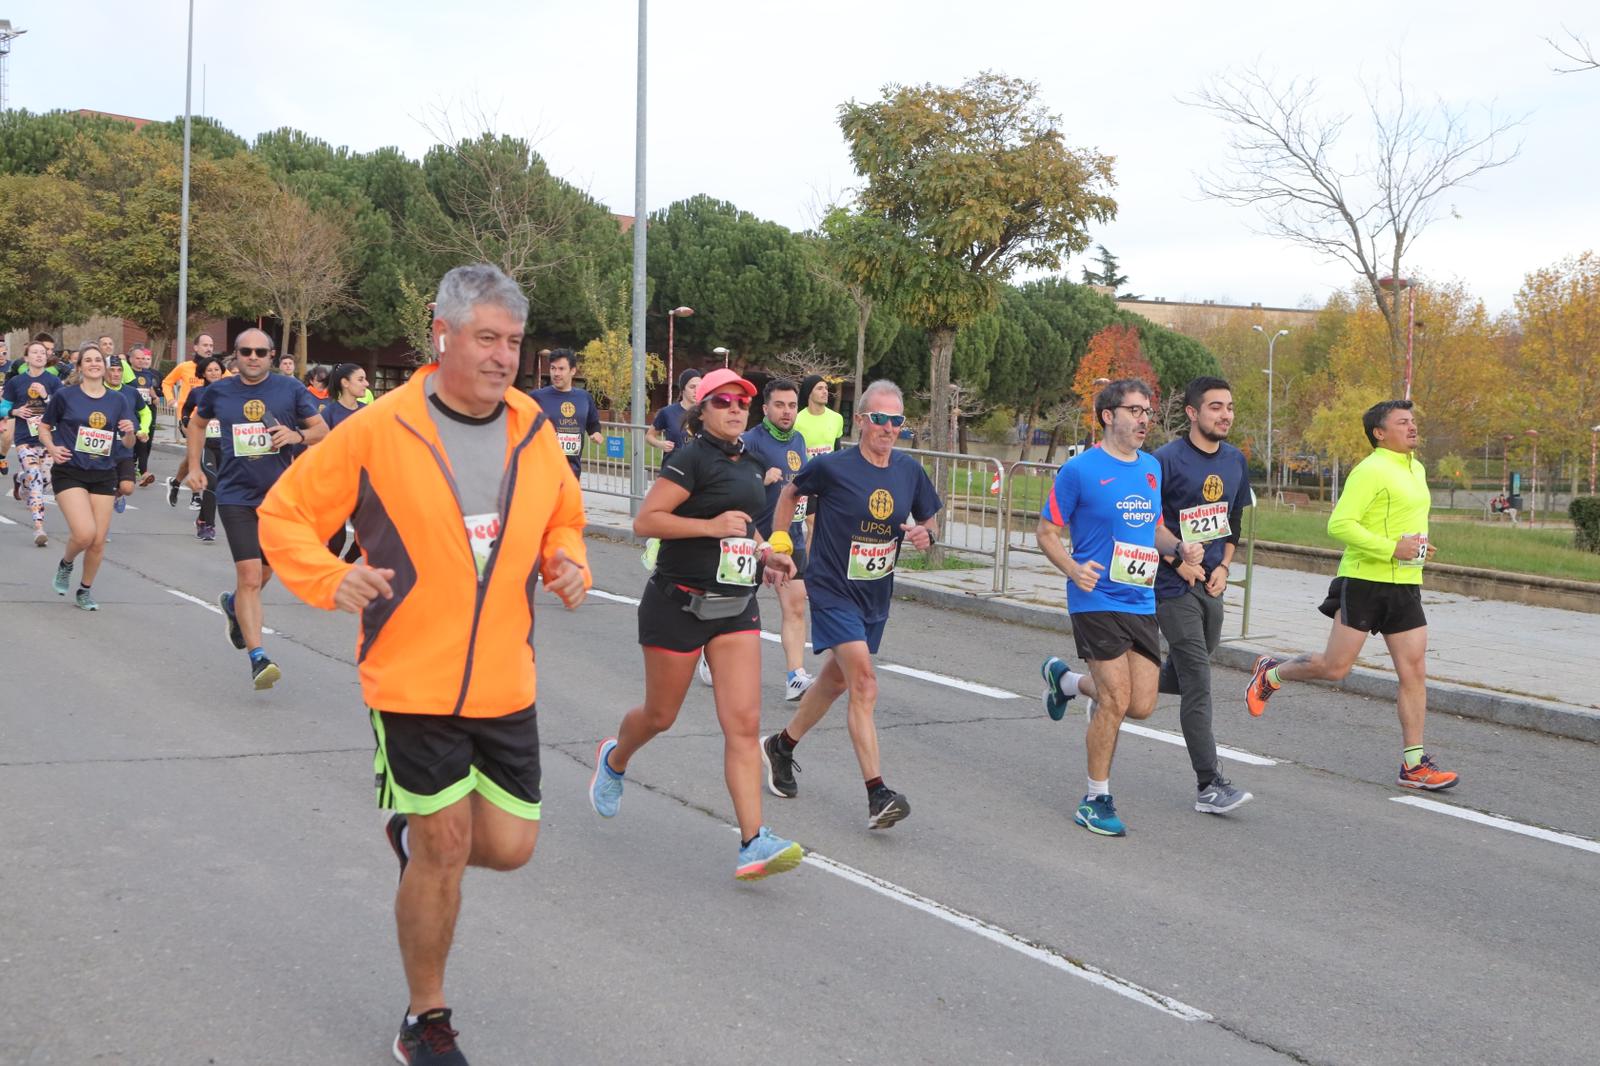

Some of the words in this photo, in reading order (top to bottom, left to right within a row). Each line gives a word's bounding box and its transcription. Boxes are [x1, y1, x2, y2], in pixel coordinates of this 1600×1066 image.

[84, 436, 107, 449] 307
[248, 435, 267, 448] 40
[561, 442, 577, 450] 100
[1116, 500, 1152, 511] capital
[1180, 504, 1227, 521] bedunia
[1123, 511, 1156, 522] energy
[1190, 515, 1219, 534] 221
[860, 520, 892, 536] UPSA
[1115, 545, 1159, 563] bedunia
[737, 556, 752, 575] 91
[866, 556, 887, 572] 63
[1127, 560, 1146, 577] 64
